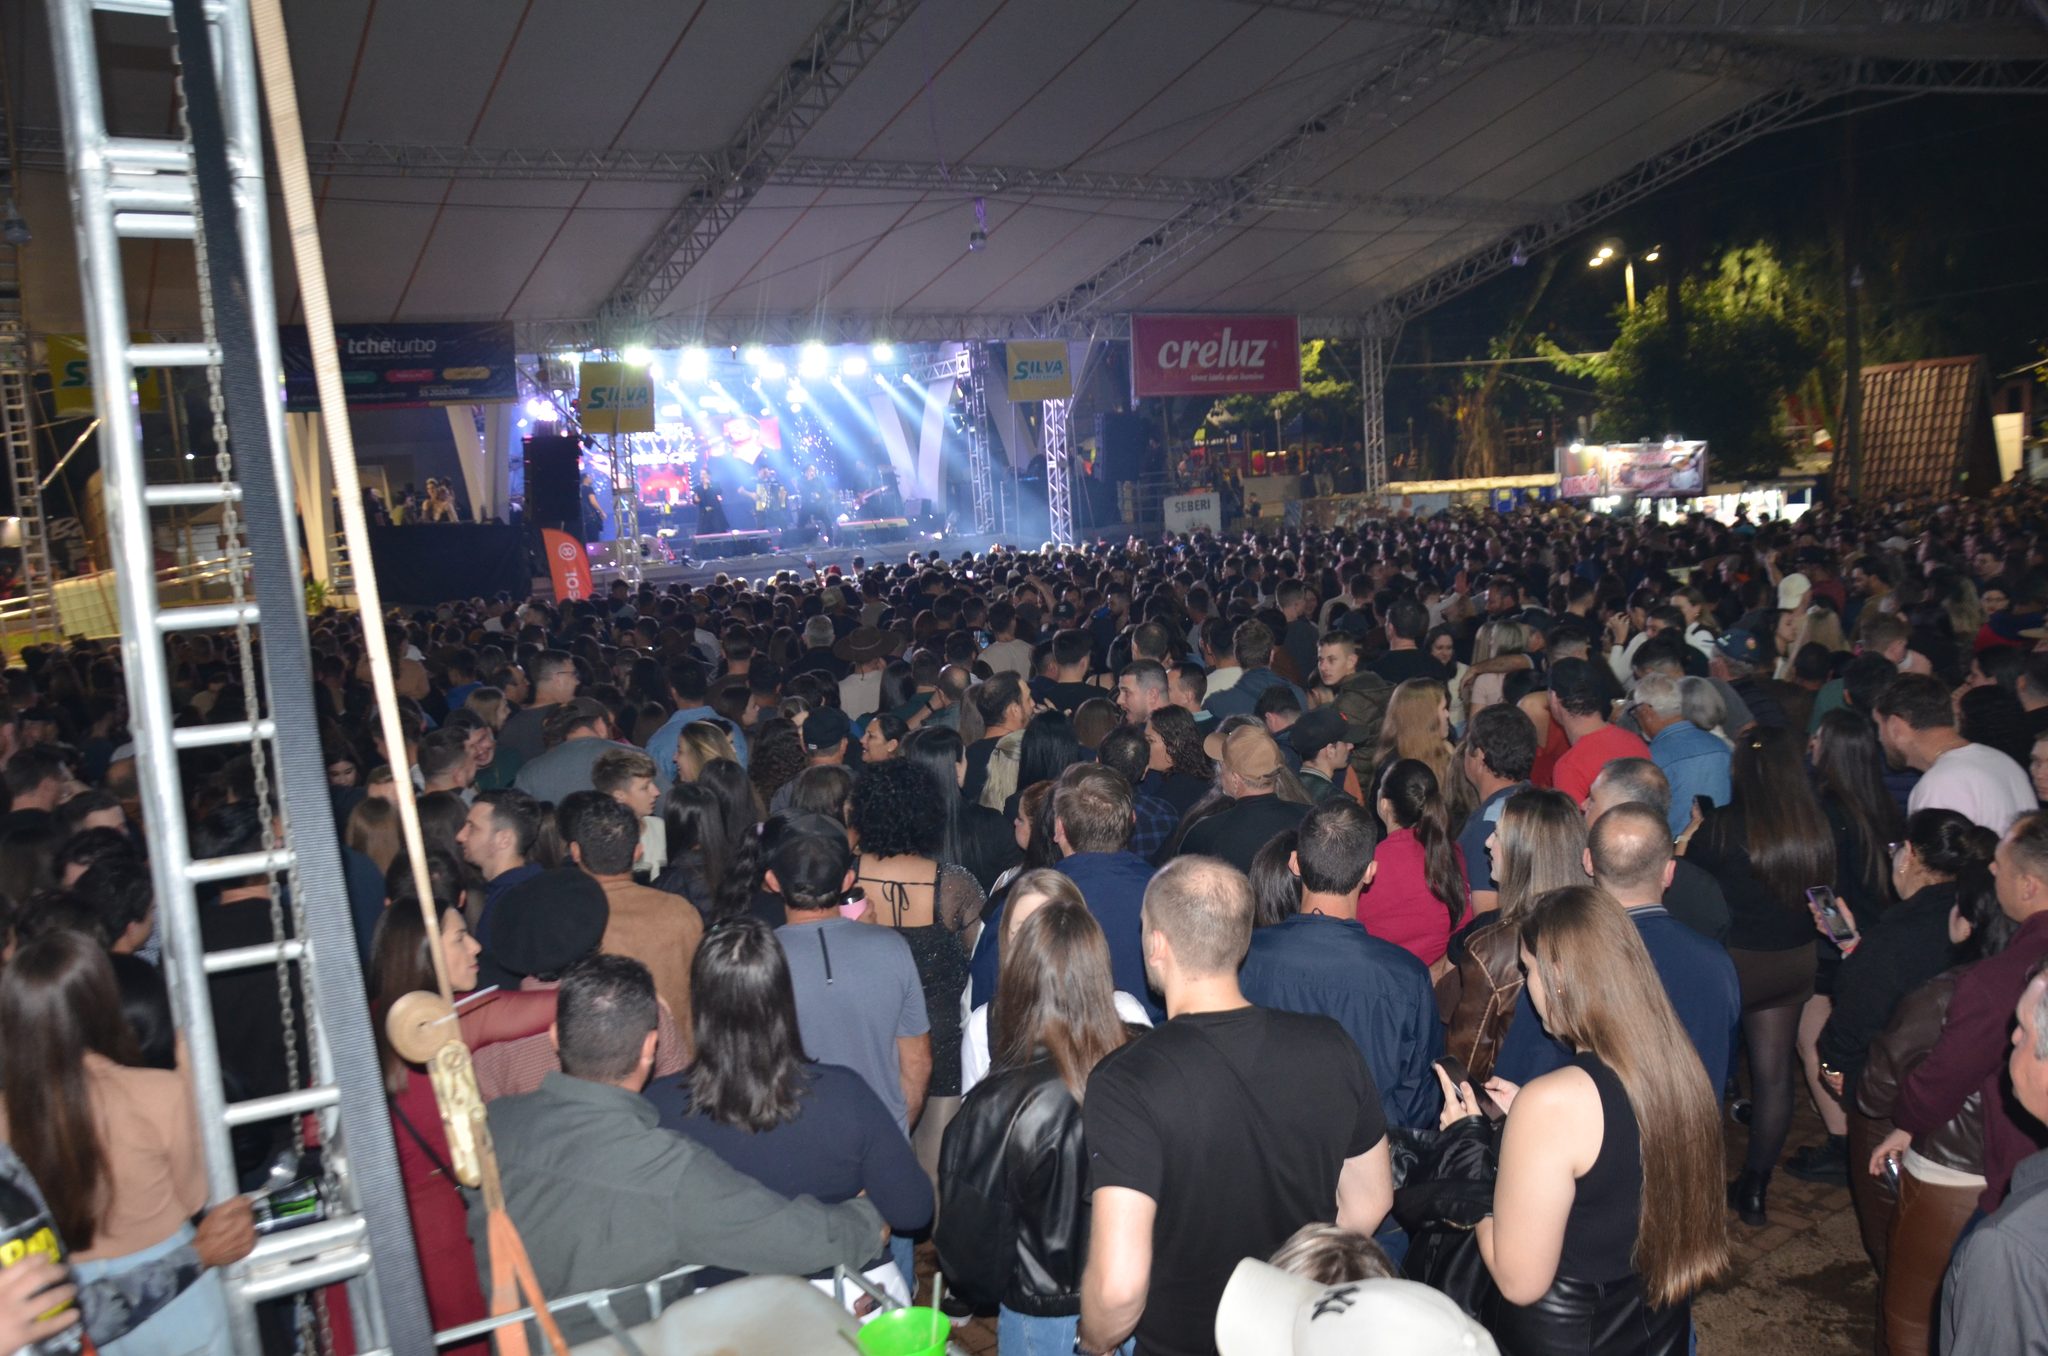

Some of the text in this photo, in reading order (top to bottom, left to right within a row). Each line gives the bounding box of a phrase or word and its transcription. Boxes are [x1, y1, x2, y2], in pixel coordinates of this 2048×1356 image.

[1158, 327, 1268, 369] creluz
[1013, 359, 1063, 380] SILVA
[587, 386, 648, 409] SILVA
[1175, 499, 1211, 513] SEBERI
